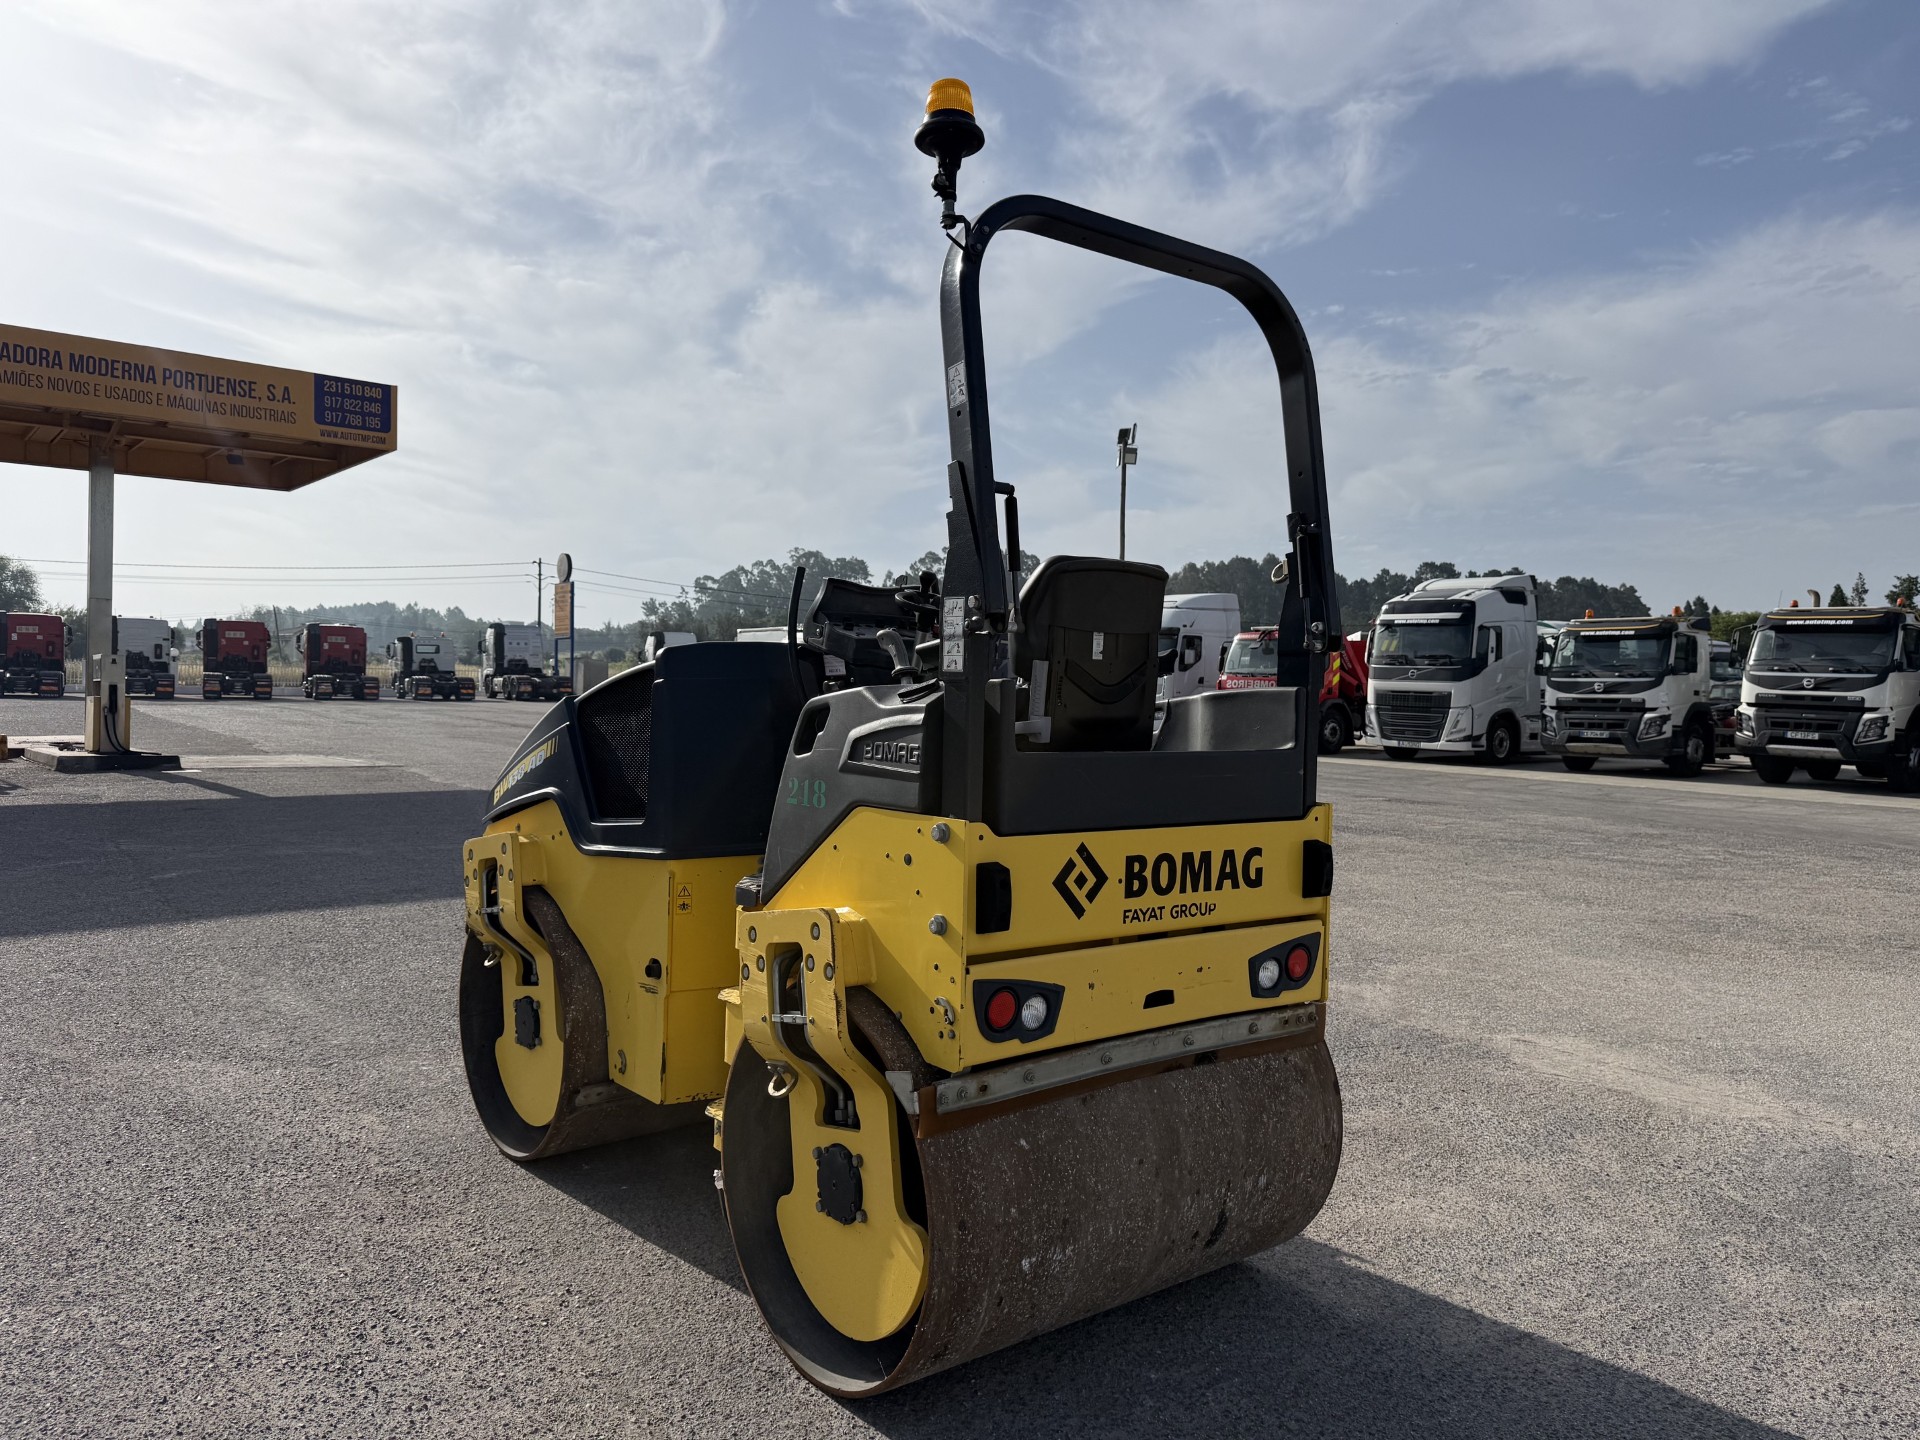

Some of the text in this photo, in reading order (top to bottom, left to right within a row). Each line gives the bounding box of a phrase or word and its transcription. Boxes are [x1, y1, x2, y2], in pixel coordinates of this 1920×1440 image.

[0, 341, 296, 405] ADORA MODERNA PORTUENSE, S.A.
[47, 376, 90, 396] NOVOS
[94, 383, 101, 397] E
[104, 384, 153, 405] USADOS
[156, 392, 163, 406] E
[166, 393, 227, 416] MÁQUINAS
[230, 403, 297, 424] INDUSTRIAIS
[324, 380, 382, 399] 231 510 840
[324, 395, 381, 414] 917 822 846
[324, 410, 381, 428] 917 768 195
[319, 429, 386, 444] WWW.AUTOTMP.COM
[527, 749, 545, 773] AD
[863, 741, 921, 765] BOMAG
[786, 777, 826, 808] 218
[1124, 847, 1263, 899] BOMAG
[1122, 901, 1216, 924] FAYAT GROUP
